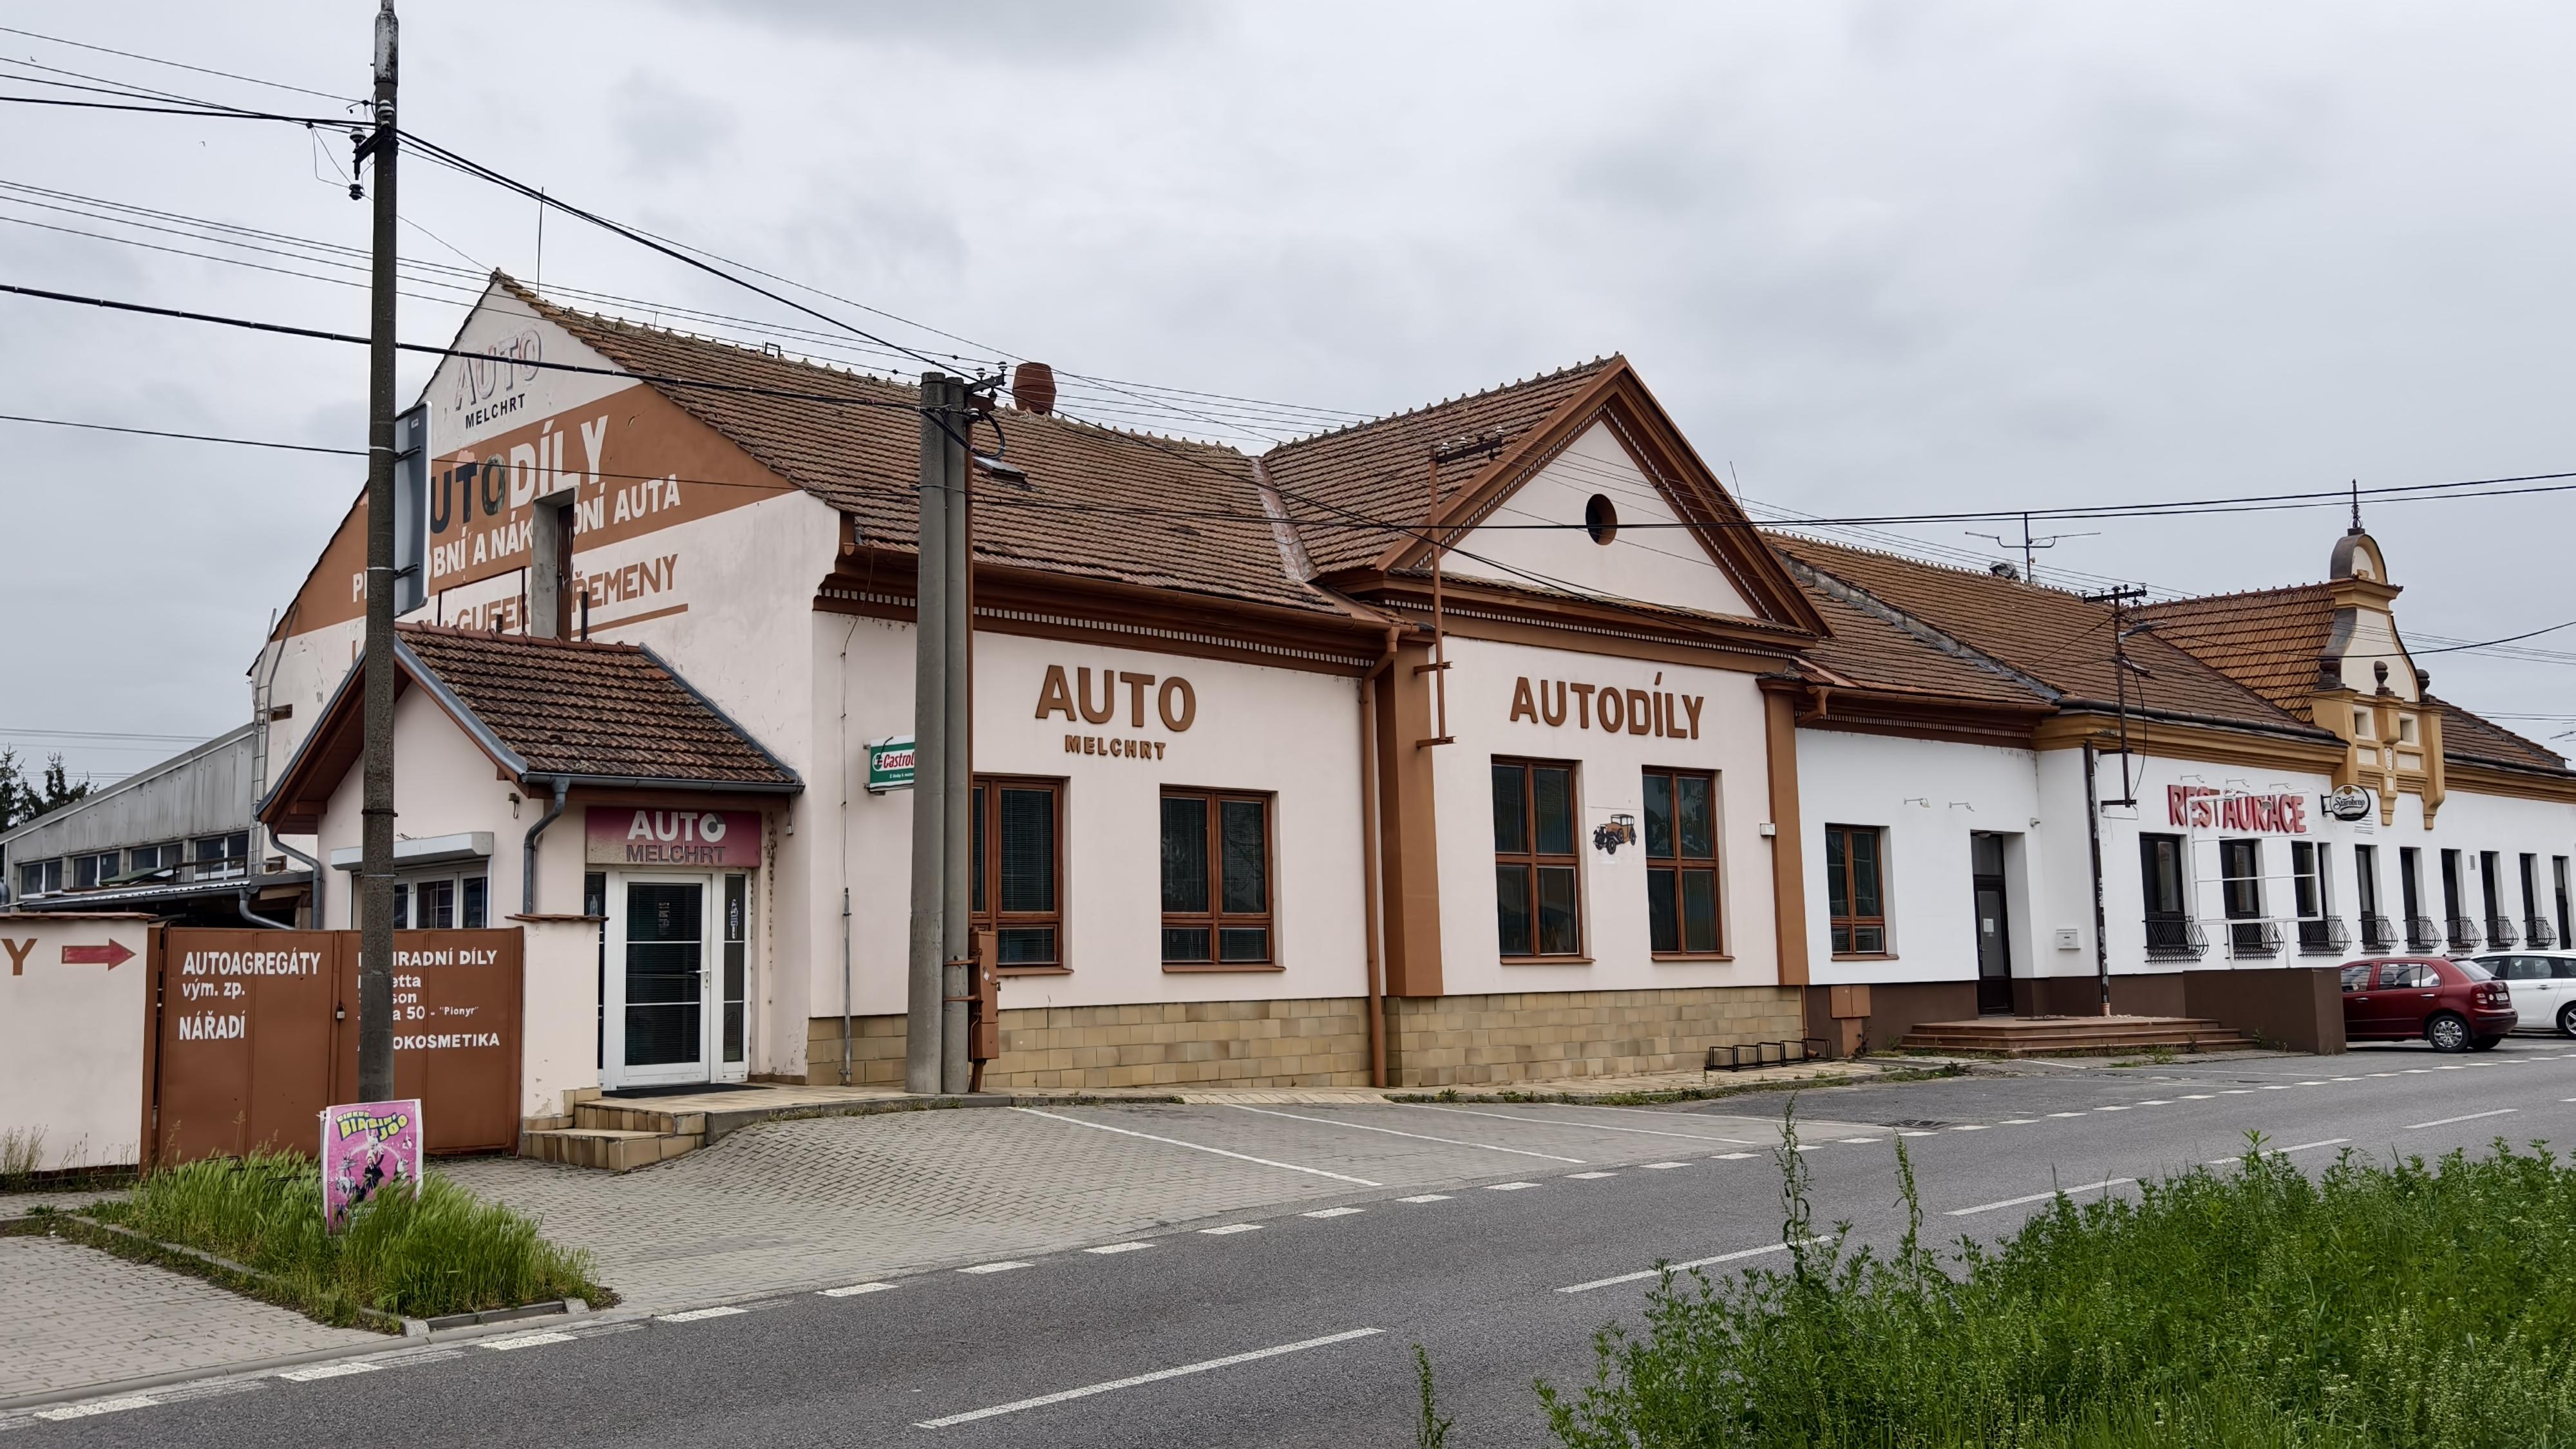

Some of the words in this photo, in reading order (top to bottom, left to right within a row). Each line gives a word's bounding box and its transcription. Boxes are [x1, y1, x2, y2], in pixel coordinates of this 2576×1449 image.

[455, 330, 542, 411] AUTO
[466, 393, 526, 430] MELCHRT
[430, 415, 609, 535] UTODÍLY
[473, 533, 487, 566] A
[614, 473, 681, 525] AUTA
[1035, 665, 1196, 732] AUTO
[1510, 672, 1704, 739] AUTODÍLY
[884, 752, 914, 768] Castrol
[1065, 735, 1166, 760] MELCHRT
[2167, 784, 2307, 833] RESTAURACE
[627, 811, 726, 843] AUTO
[626, 844, 726, 864] MELCHRT
[182, 947, 321, 975] AUTOAGREGÁTY
[459, 947, 497, 965] DÍLY
[182, 978, 218, 1001] vým.
[223, 982, 245, 999] zp.
[179, 1010, 245, 1040] NÁŘADÍ
[406, 1006, 425, 1019] 50
[379, 1114, 408, 1142] JOO
